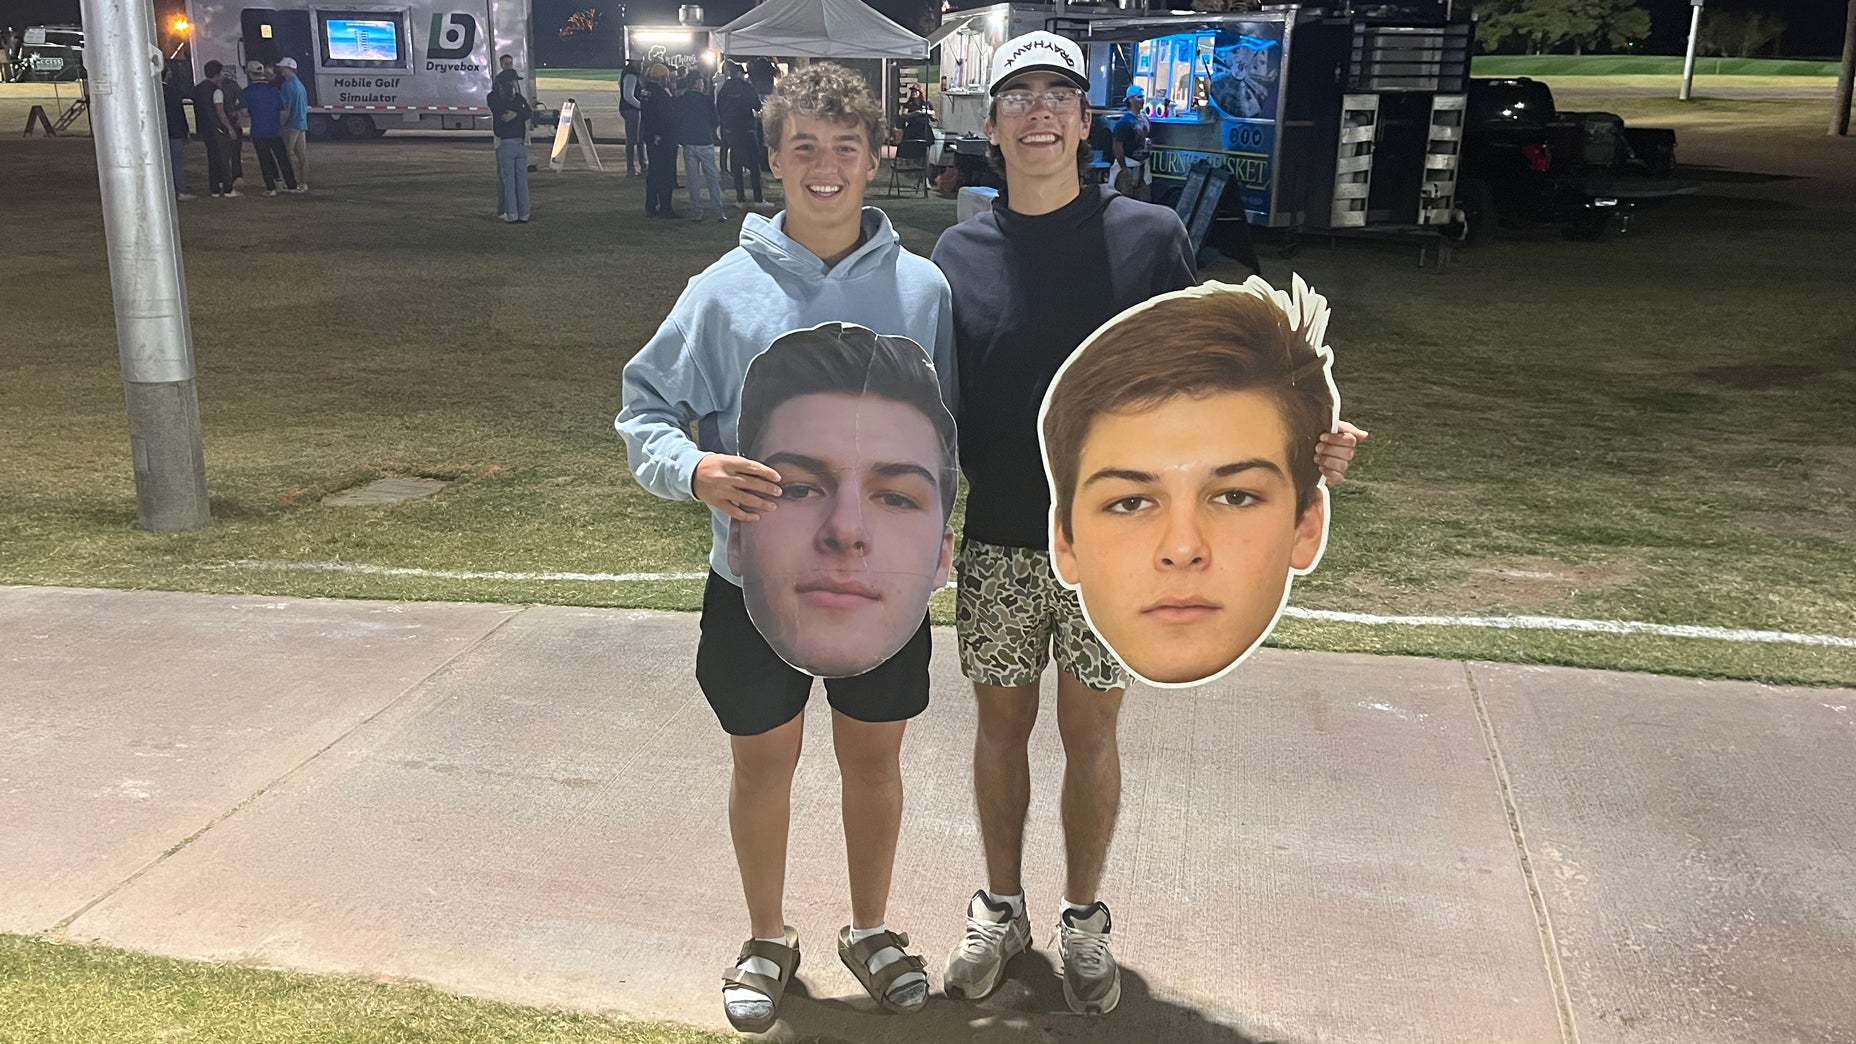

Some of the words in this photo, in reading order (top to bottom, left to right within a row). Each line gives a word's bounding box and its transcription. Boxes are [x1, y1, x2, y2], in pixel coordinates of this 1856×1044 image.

[1003, 40, 1075, 67] GRAYHAWK
[426, 61, 480, 73] Dryvebox
[334, 78, 371, 88] Mobile
[375, 78, 401, 88] Golf
[339, 92, 397, 102] Simulator
